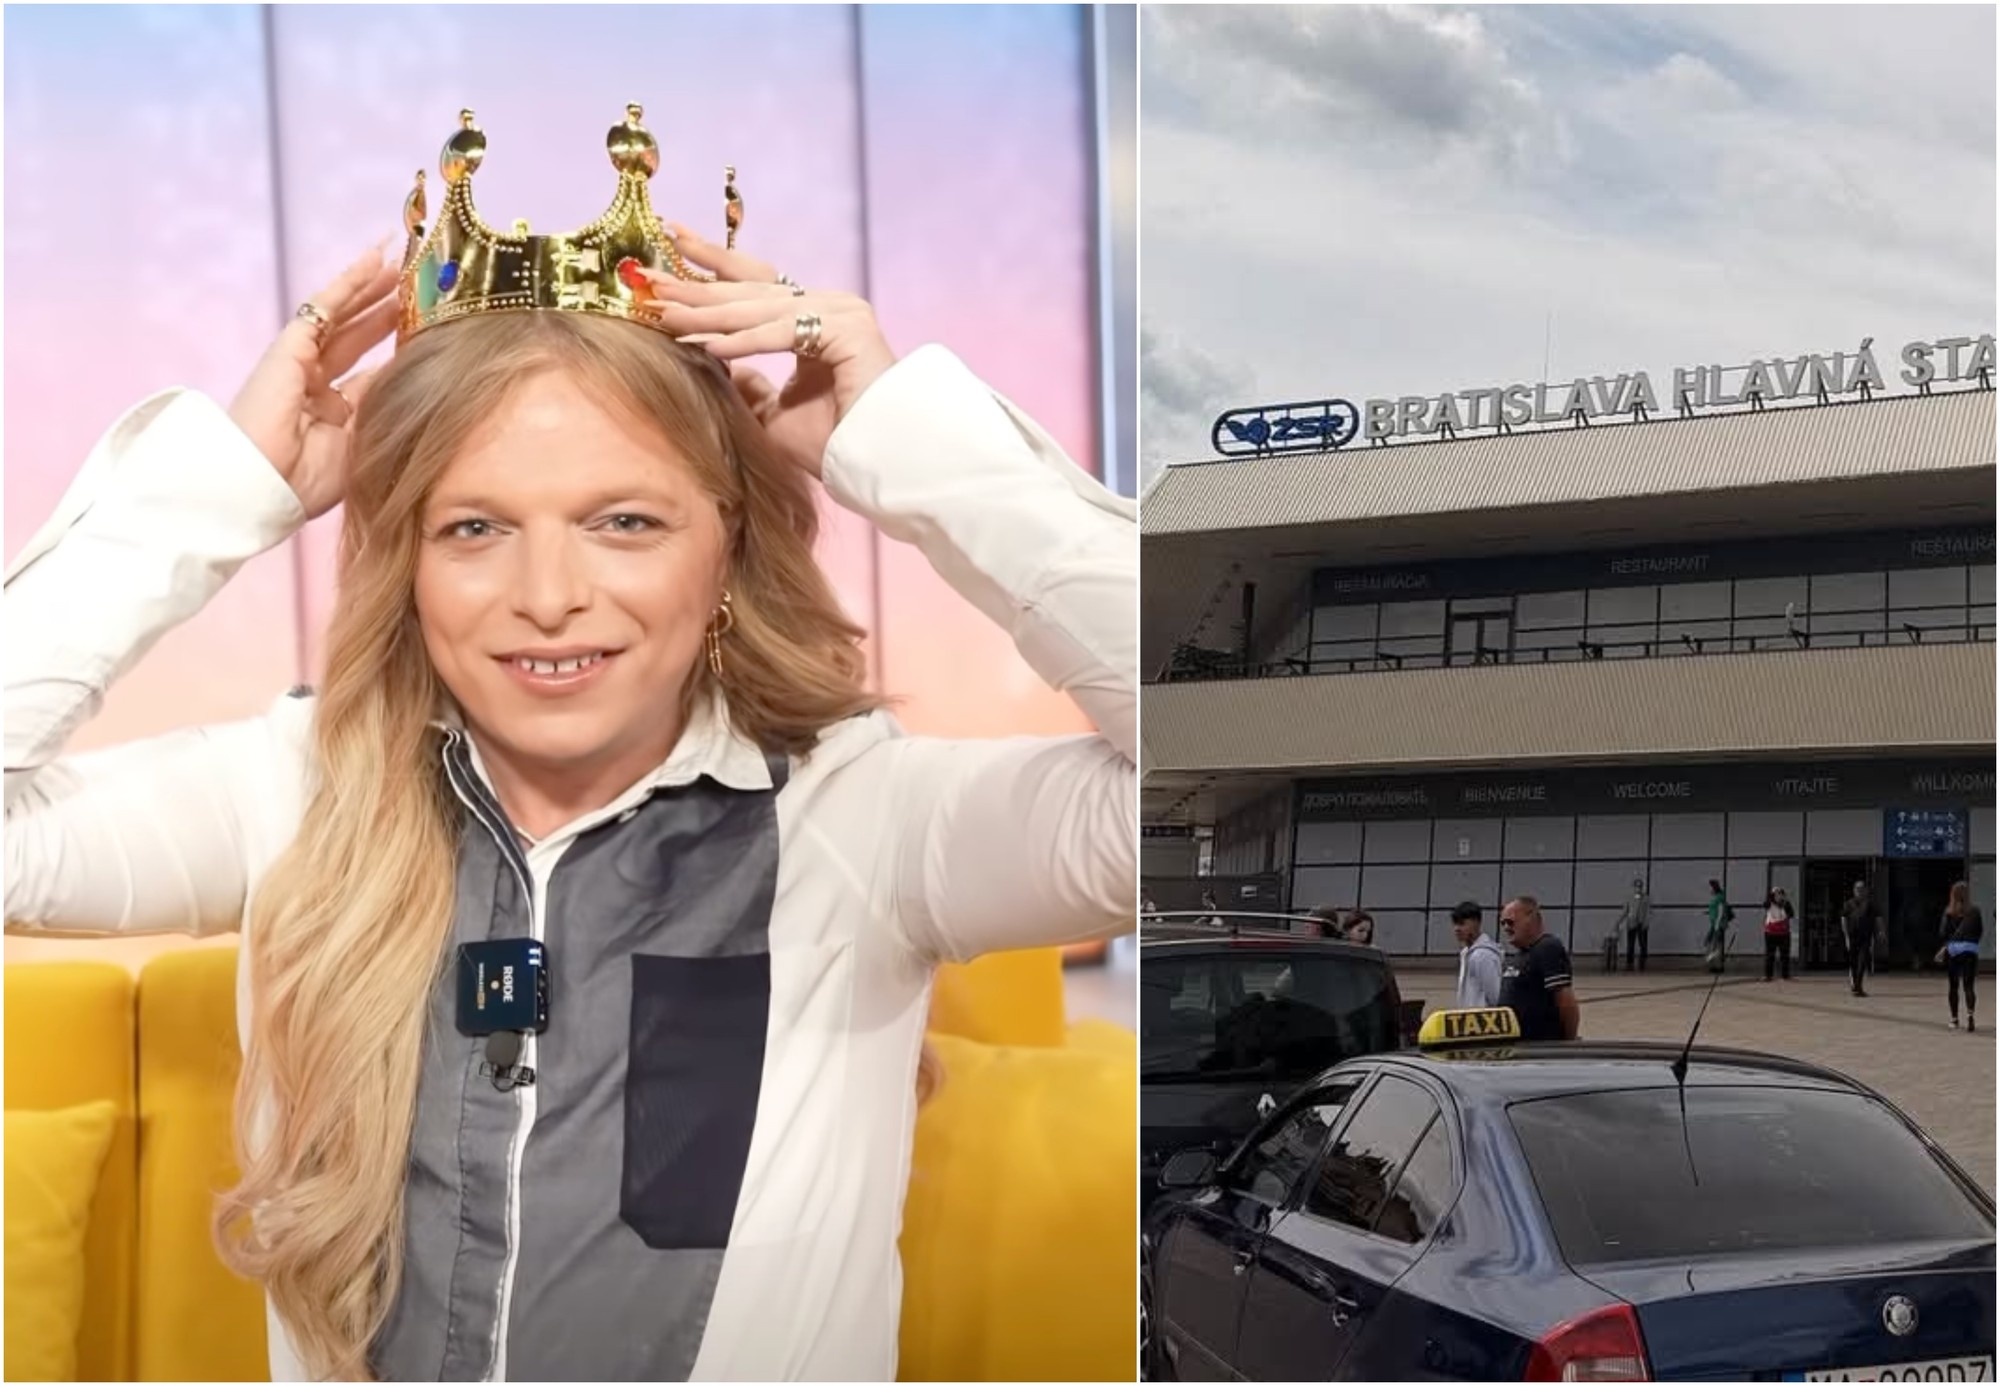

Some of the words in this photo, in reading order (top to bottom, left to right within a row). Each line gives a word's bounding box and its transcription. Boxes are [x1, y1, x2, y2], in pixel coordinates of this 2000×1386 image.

[1364, 372, 1657, 439] BRATISLAVA
[1672, 338, 1885, 410] HLAVNÁ
[1901, 334, 1995, 387] STA
[1614, 782, 1693, 799] WELCOME
[1773, 777, 1838, 794] VITAJTE
[1464, 786, 1547, 804] BIENVENUE
[1448, 1012, 1509, 1038] TAXI
